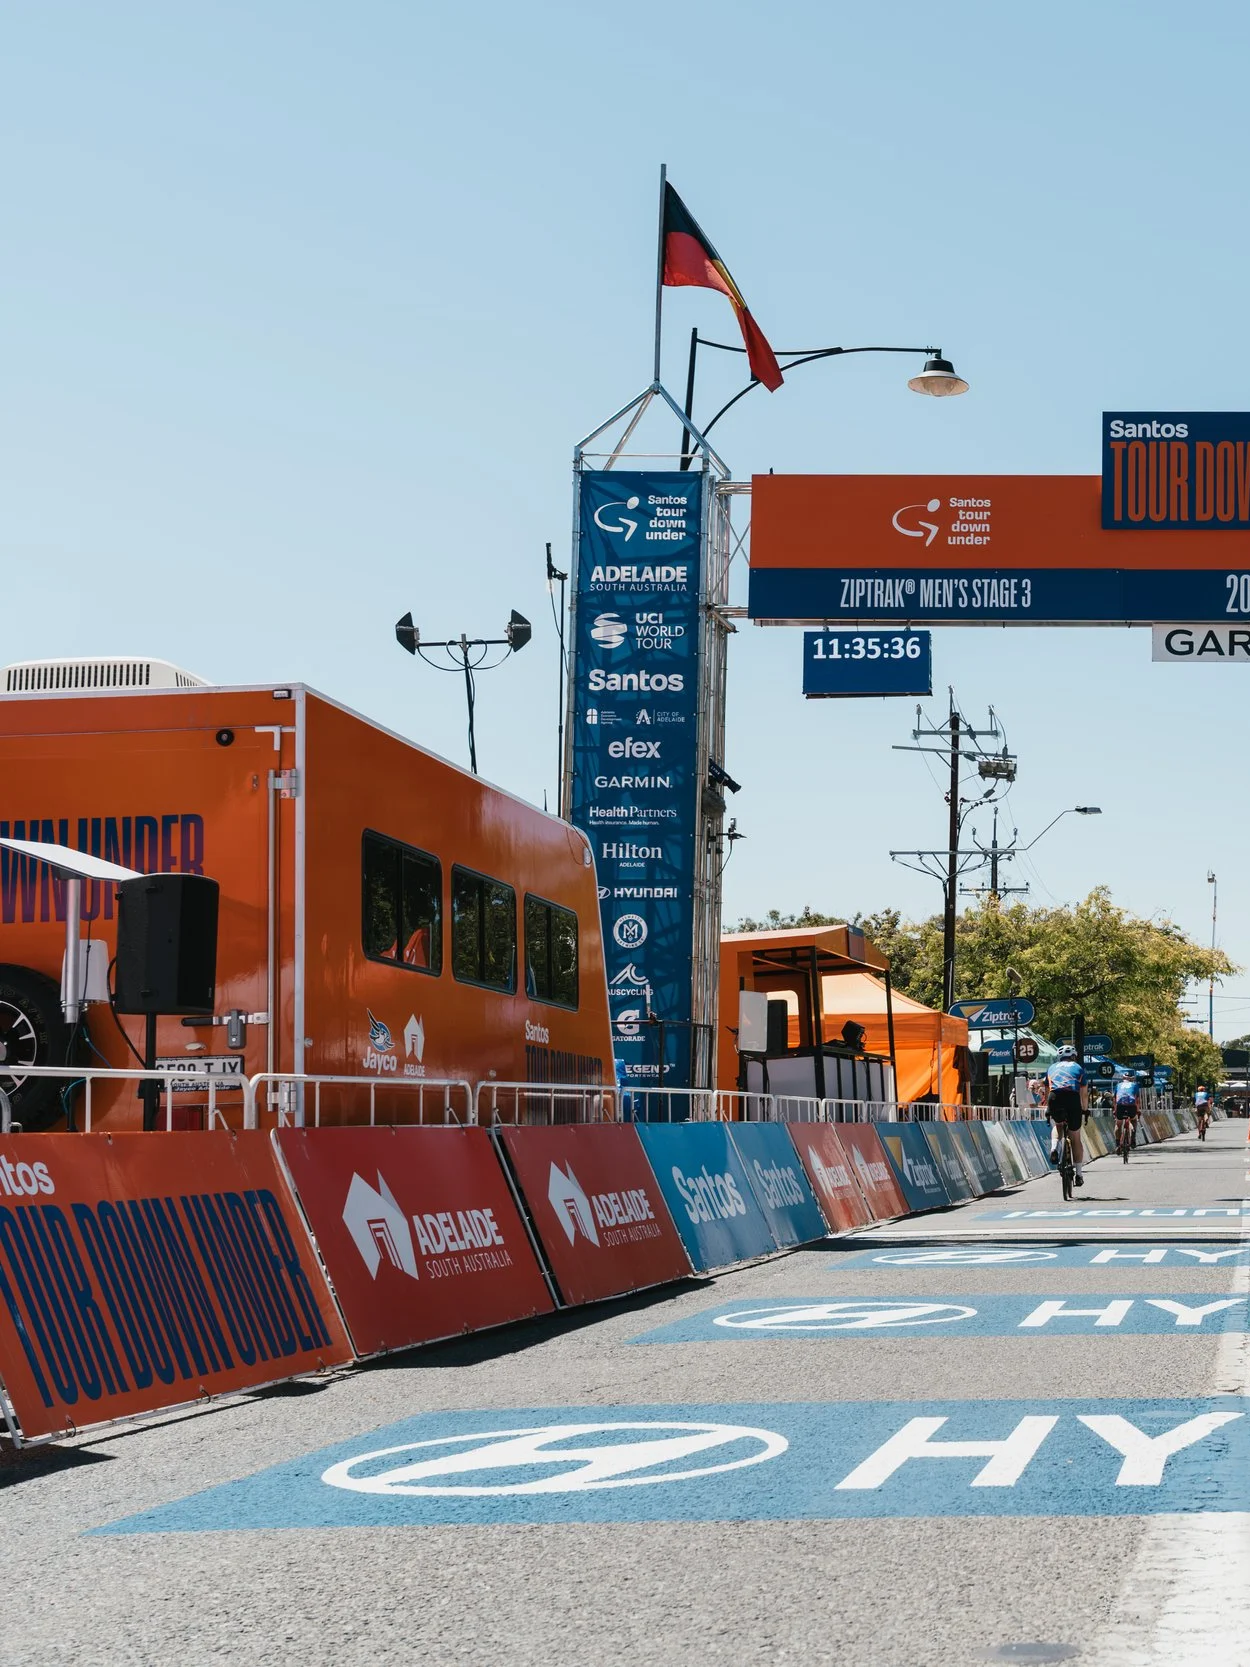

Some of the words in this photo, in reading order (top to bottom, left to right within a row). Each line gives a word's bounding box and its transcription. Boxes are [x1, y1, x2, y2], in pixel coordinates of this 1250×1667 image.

[1110, 420, 1189, 438] Santos
[1111, 441, 1188, 522] TOUR
[648, 495, 687, 505] Santos
[949, 497, 991, 507] Santos
[656, 507, 686, 517] tour
[958, 510, 990, 520] tour
[649, 518, 686, 528] down
[951, 522, 990, 532] down
[645, 530, 686, 540] under
[947, 535, 990, 545] under
[590, 566, 687, 583] ADELAIDE
[590, 583, 625, 592] SOUTH
[630, 583, 687, 592] AUSTRALIA
[972, 578, 1018, 608] STAGE
[1021, 578, 1032, 608] 3
[635, 613, 663, 624] UCI
[636, 625, 684, 637] WORLD
[636, 638, 672, 649] TOUR
[813, 637, 920, 660] 11:35:36
[588, 669, 684, 692] Santos
[608, 737, 661, 758] efex
[595, 776, 672, 788] GARMIN
[602, 843, 662, 859] Hilton
[614, 887, 678, 898] HYUNDAI
[525, 1019, 549, 1044] Santos
[1020, 1045, 1033, 1056] 25
[1083, 1043, 1104, 1051] ptrak
[363, 1046, 397, 1074] Jayco
[404, 1064, 425, 1077] ADELAIDE
[1102, 1066, 1112, 1074] 50
[754, 1159, 805, 1210] Santos
[672, 1165, 746, 1224] Santos
[591, 1189, 654, 1227] ADELAIDE
[413, 1208, 504, 1255] ADELAIDE
[603, 1229, 628, 1247] SOUTH
[629, 1224, 662, 1242] AUSTRALIA
[426, 1255, 462, 1279] SOUTH
[464, 1250, 513, 1273] AUSTRALIA
[71, 1197, 236, 1391] DOWN
[181, 1189, 333, 1367] UNDER
